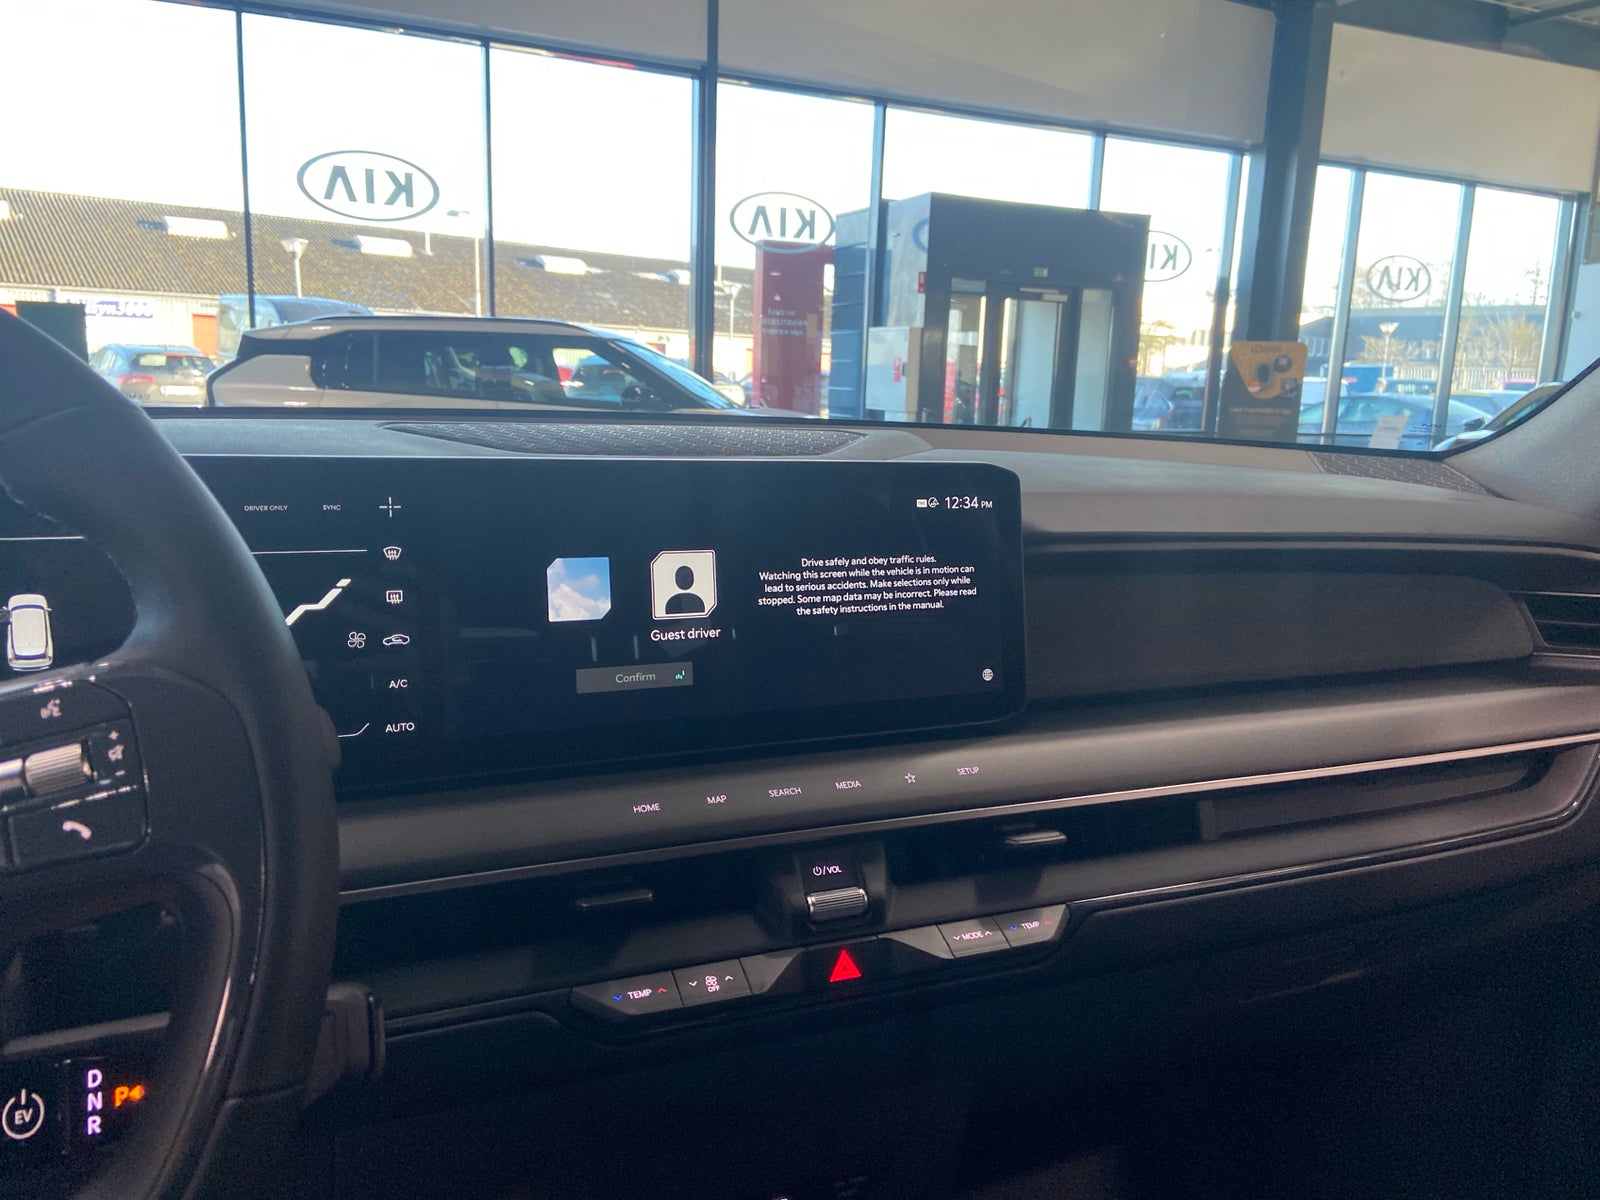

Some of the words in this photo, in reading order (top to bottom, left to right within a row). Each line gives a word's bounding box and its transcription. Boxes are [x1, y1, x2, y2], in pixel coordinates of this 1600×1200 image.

[944, 496, 978, 509] 12:34
[980, 500, 993, 508] PM
[801, 558, 823, 567] Drive
[825, 557, 849, 567] safely
[851, 557, 867, 565] and
[868, 556, 888, 565] obey
[889, 555, 915, 564] traffic
[916, 555, 936, 563] rules.
[759, 572, 801, 581] Watching
[803, 570, 818, 579] this
[848, 569, 870, 577] while
[872, 568, 885, 576] the
[886, 567, 914, 576] vehicle
[764, 584, 783, 592] lead
[785, 584, 794, 592] to
[796, 582, 826, 592] serious
[827, 581, 868, 590] accidents.
[870, 580, 892, 588] Make
[893, 578, 932, 587] selections
[933, 577, 949, 586] only
[950, 576, 971, 585] while
[758, 595, 796, 606] stopped.
[797, 595, 821, 603] Some
[843, 592, 862, 601] data
[883, 591, 894, 599] be
[894, 590, 932, 599] incorrect.
[933, 588, 958, 597] Please
[959, 587, 977, 595] read
[796, 606, 810, 615] the
[812, 605, 838, 615] safety
[840, 603, 887, 613] instructions
[889, 602, 896, 610] in
[898, 602, 911, 610] the
[912, 600, 944, 609] manual.
[650, 629, 686, 641] Guest
[688, 628, 722, 640] driver
[389, 679, 408, 688] A/C
[616, 673, 656, 683] Confirm
[385, 722, 415, 732] AUTO
[957, 766, 980, 776] SETUP
[835, 779, 861, 790] MEDIA
[768, 787, 802, 798] SEARCH
[707, 794, 727, 805] MAP
[633, 802, 660, 814] HOME
[1020, 921, 1040, 930] TEMP
[961, 930, 984, 940] MODE
[627, 988, 652, 1000] TEMP
[86, 1069, 102, 1088] D
[86, 1091, 102, 1110] N
[14, 1108, 33, 1125] EV
[86, 1115, 102, 1135] R
